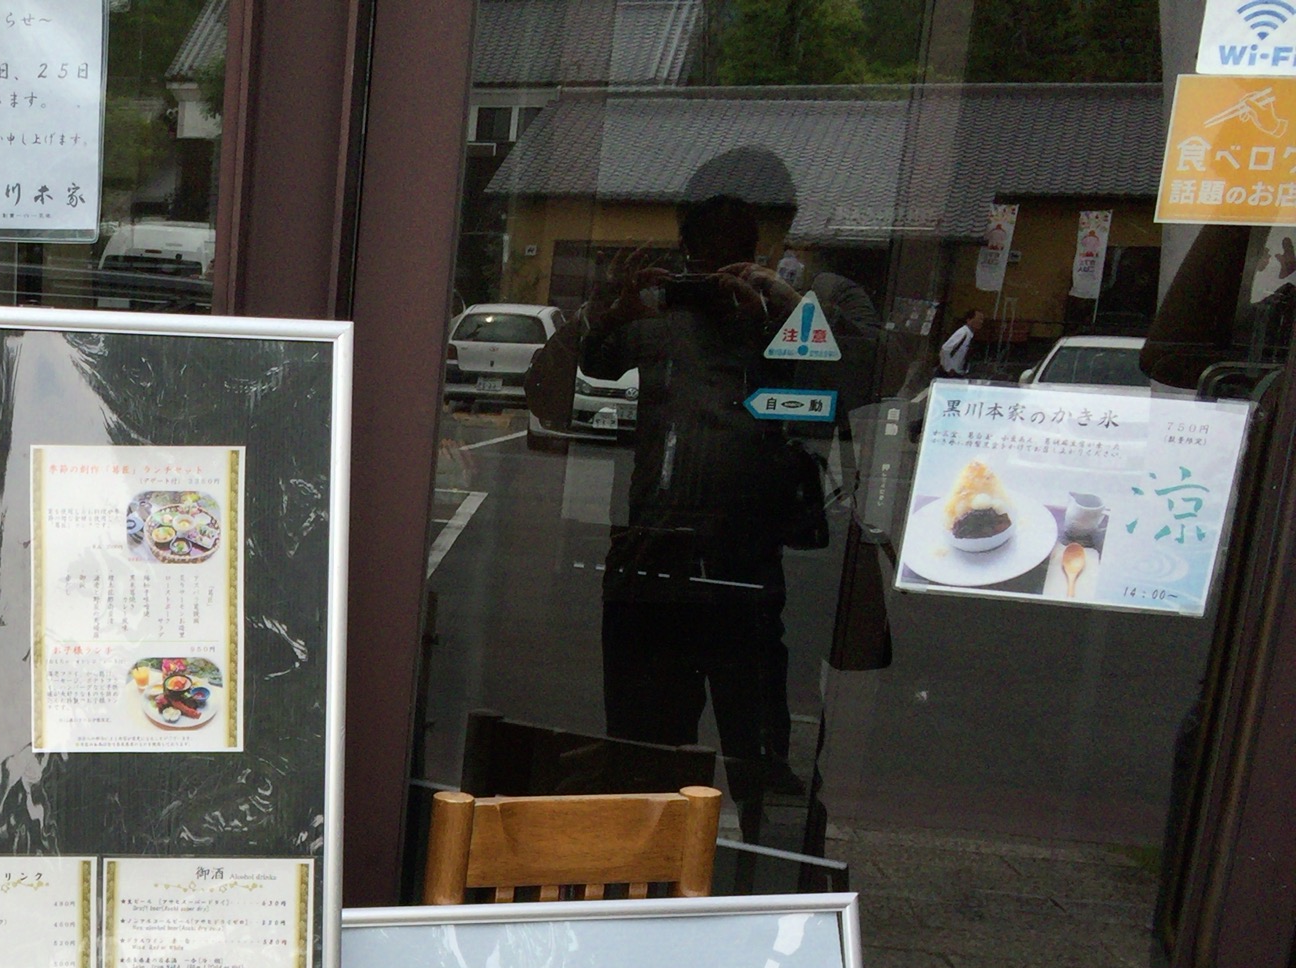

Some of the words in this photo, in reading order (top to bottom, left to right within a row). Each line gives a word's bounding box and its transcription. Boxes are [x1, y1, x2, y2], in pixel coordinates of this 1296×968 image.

[942, 399, 1120, 429] 黒川本家のかき氷
[1125, 466, 1211, 544] 涼
[195, 866, 225, 881] 御酒
